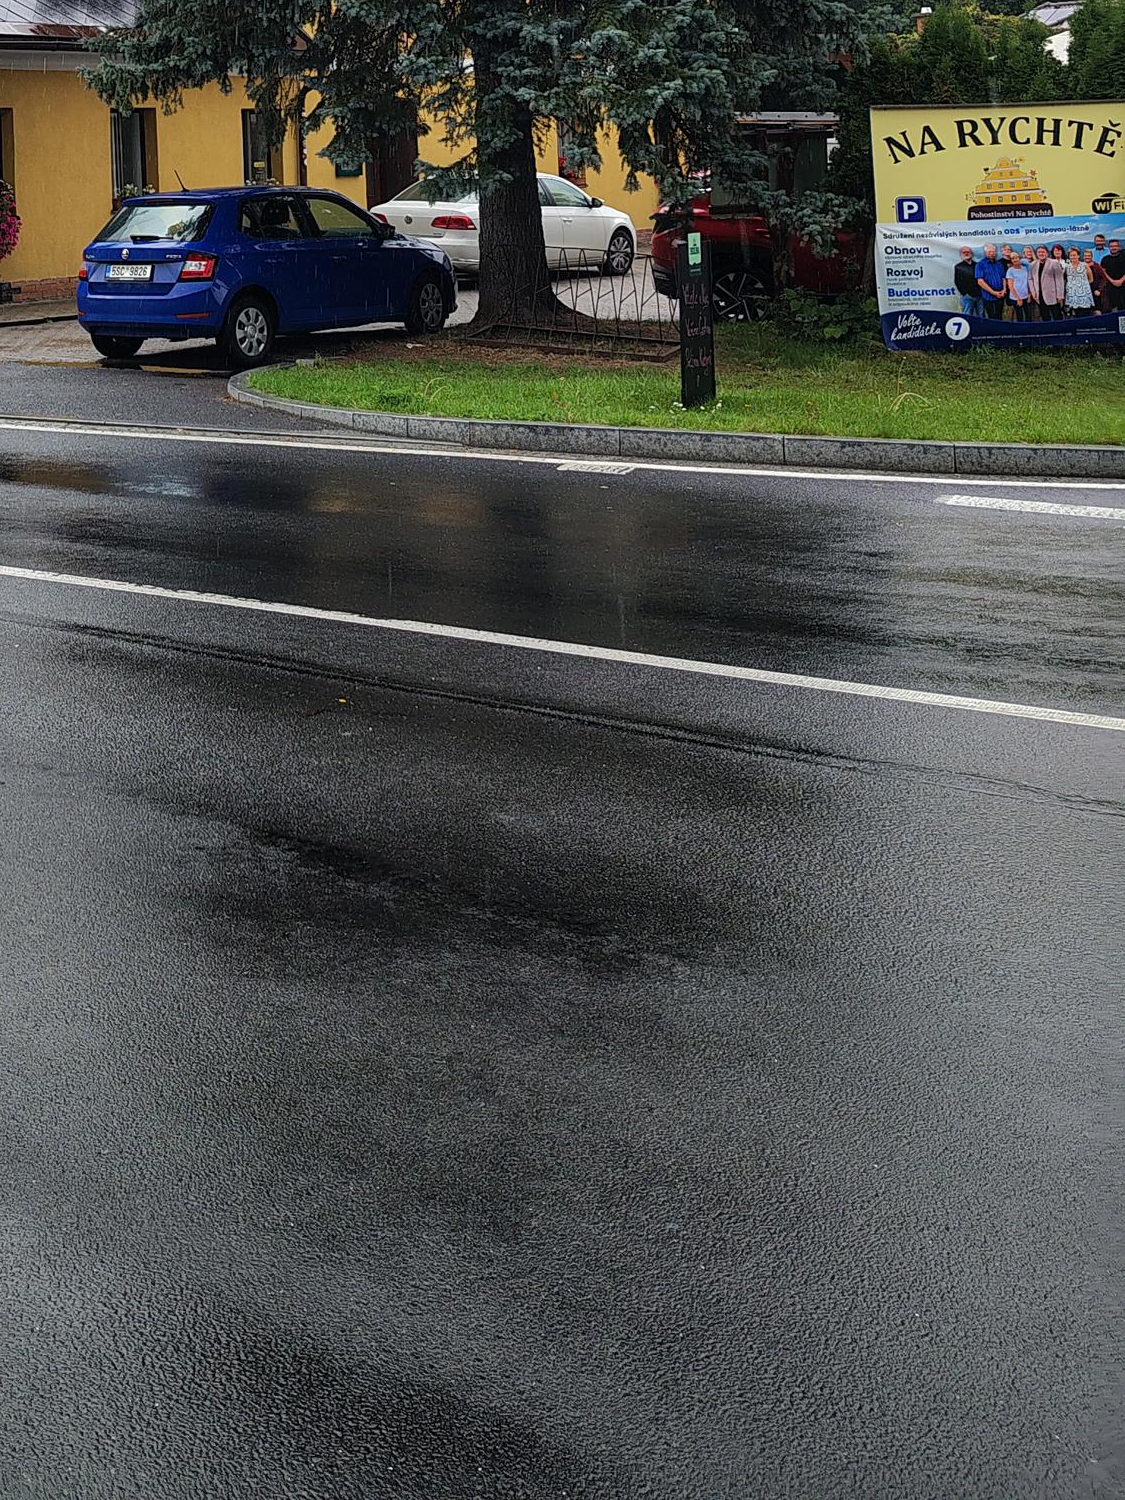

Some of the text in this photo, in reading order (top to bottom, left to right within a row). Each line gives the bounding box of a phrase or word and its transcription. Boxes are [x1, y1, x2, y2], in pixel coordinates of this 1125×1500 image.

[883, 116, 1122, 164] NA RYCHTĚ
[902, 201, 919, 220] P
[884, 246, 930, 255] Obnova
[886, 266, 923, 278] Rozvoj
[888, 287, 956, 297] Budoucnost
[897, 313, 922, 330] Volte
[952, 322, 963, 336] 7
[890, 322, 942, 341] kandidátka
